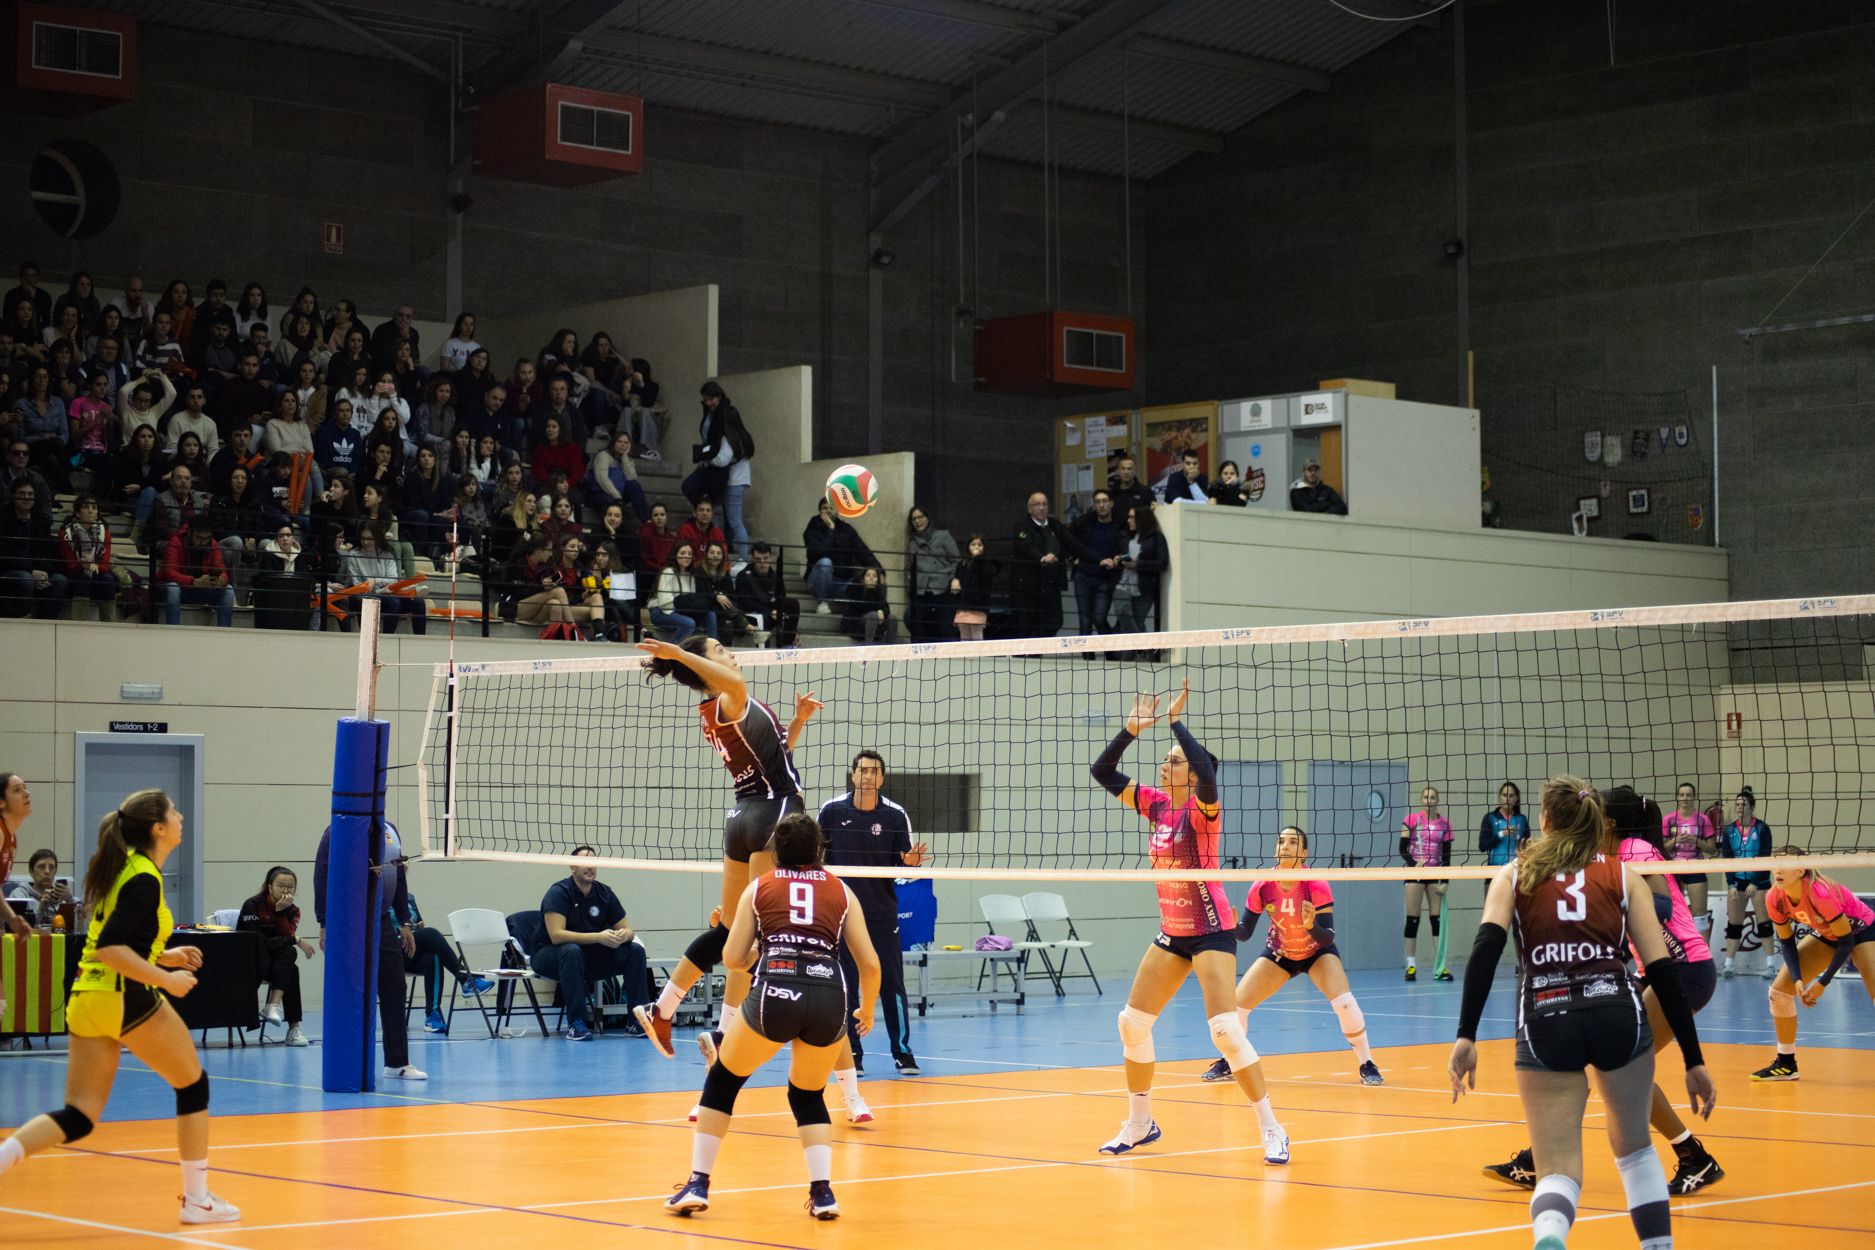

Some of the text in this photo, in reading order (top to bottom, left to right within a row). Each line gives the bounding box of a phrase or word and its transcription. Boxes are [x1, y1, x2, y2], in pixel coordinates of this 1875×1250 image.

[112, 722, 159, 731] Vestidors 1-2
[774, 868, 827, 881] OLIVARES
[789, 881, 814, 926] 9
[1555, 867, 1587, 922] 3
[1280, 897, 1296, 917] 4
[1530, 941, 1615, 966] GRIFOLS
[766, 985, 803, 1002] DSV
